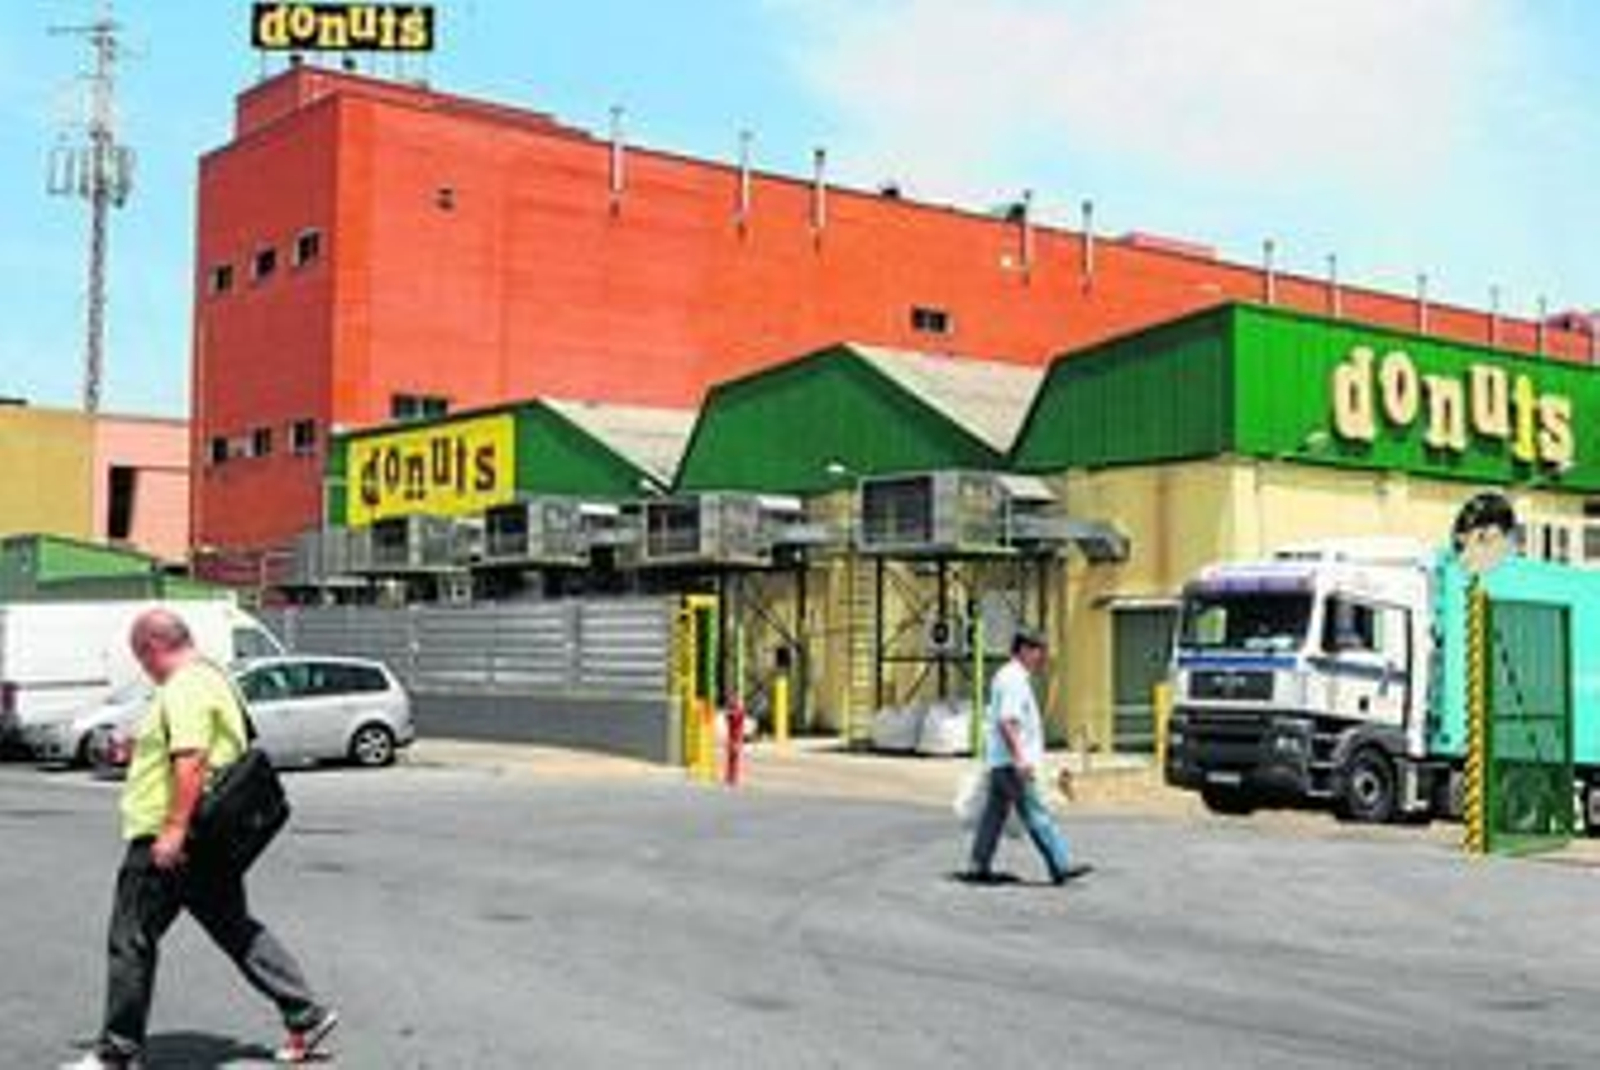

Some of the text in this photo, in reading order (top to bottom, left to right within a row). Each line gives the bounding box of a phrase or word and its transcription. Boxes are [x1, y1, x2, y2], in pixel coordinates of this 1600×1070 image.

[259, 4, 428, 48] donuts
[1334, 346, 1575, 463] donuts
[361, 437, 496, 505] donuts
